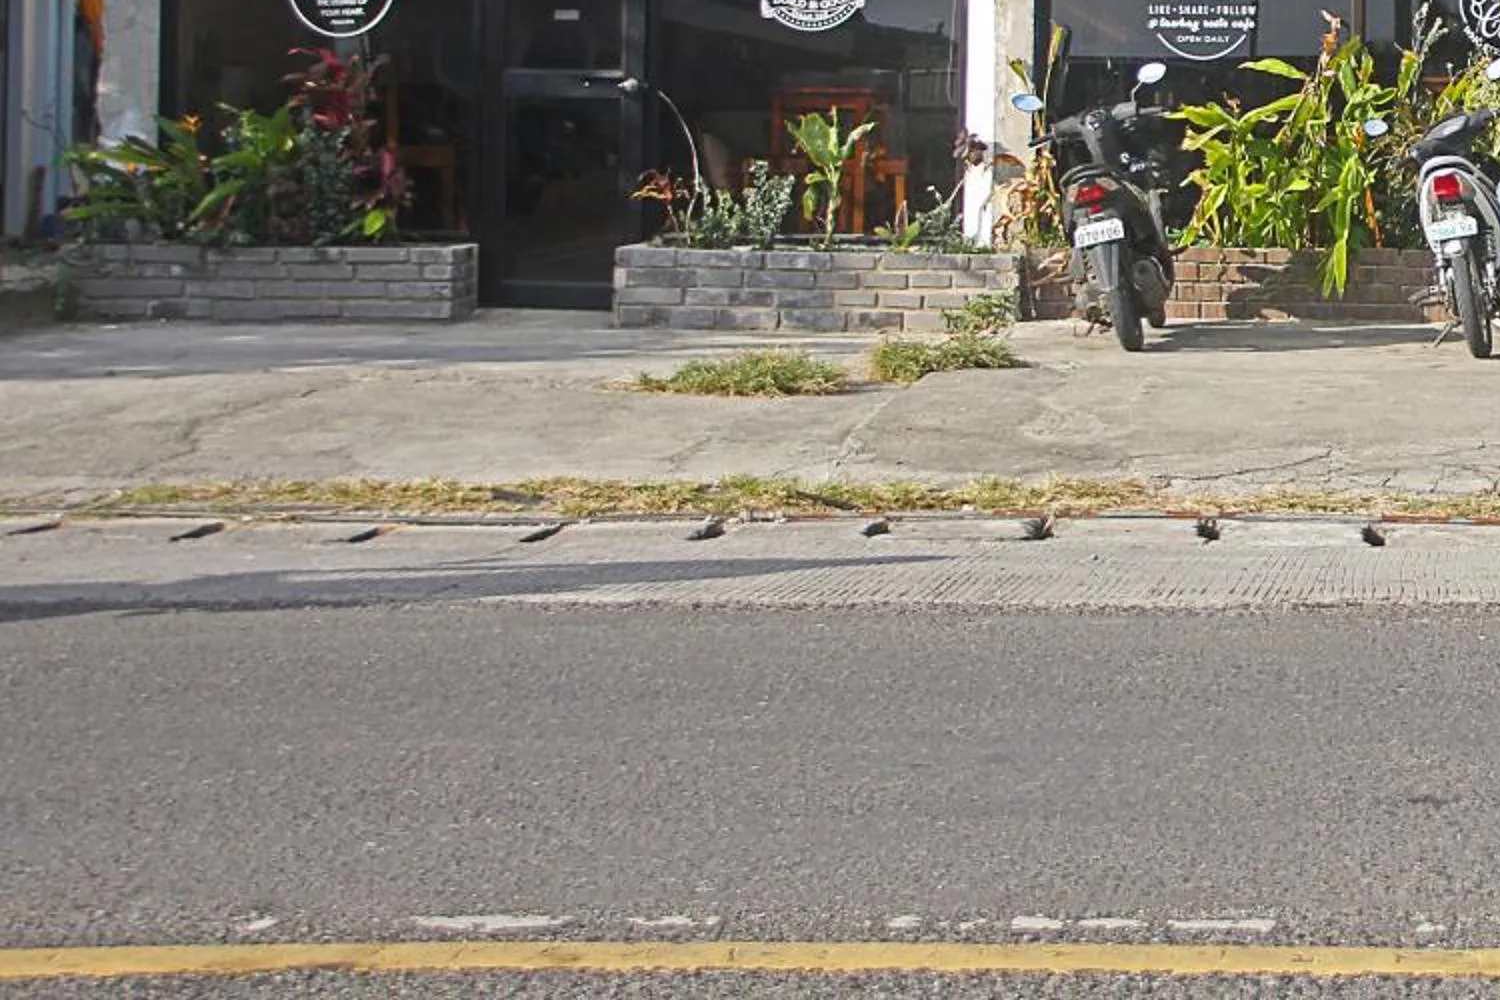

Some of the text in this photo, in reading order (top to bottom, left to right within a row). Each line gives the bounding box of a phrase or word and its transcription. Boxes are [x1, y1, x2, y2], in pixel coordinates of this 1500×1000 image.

[1148, 5, 1257, 16] LIKE SHARE FOLLOW
[1176, 35, 1230, 43] OPEN DAILY
